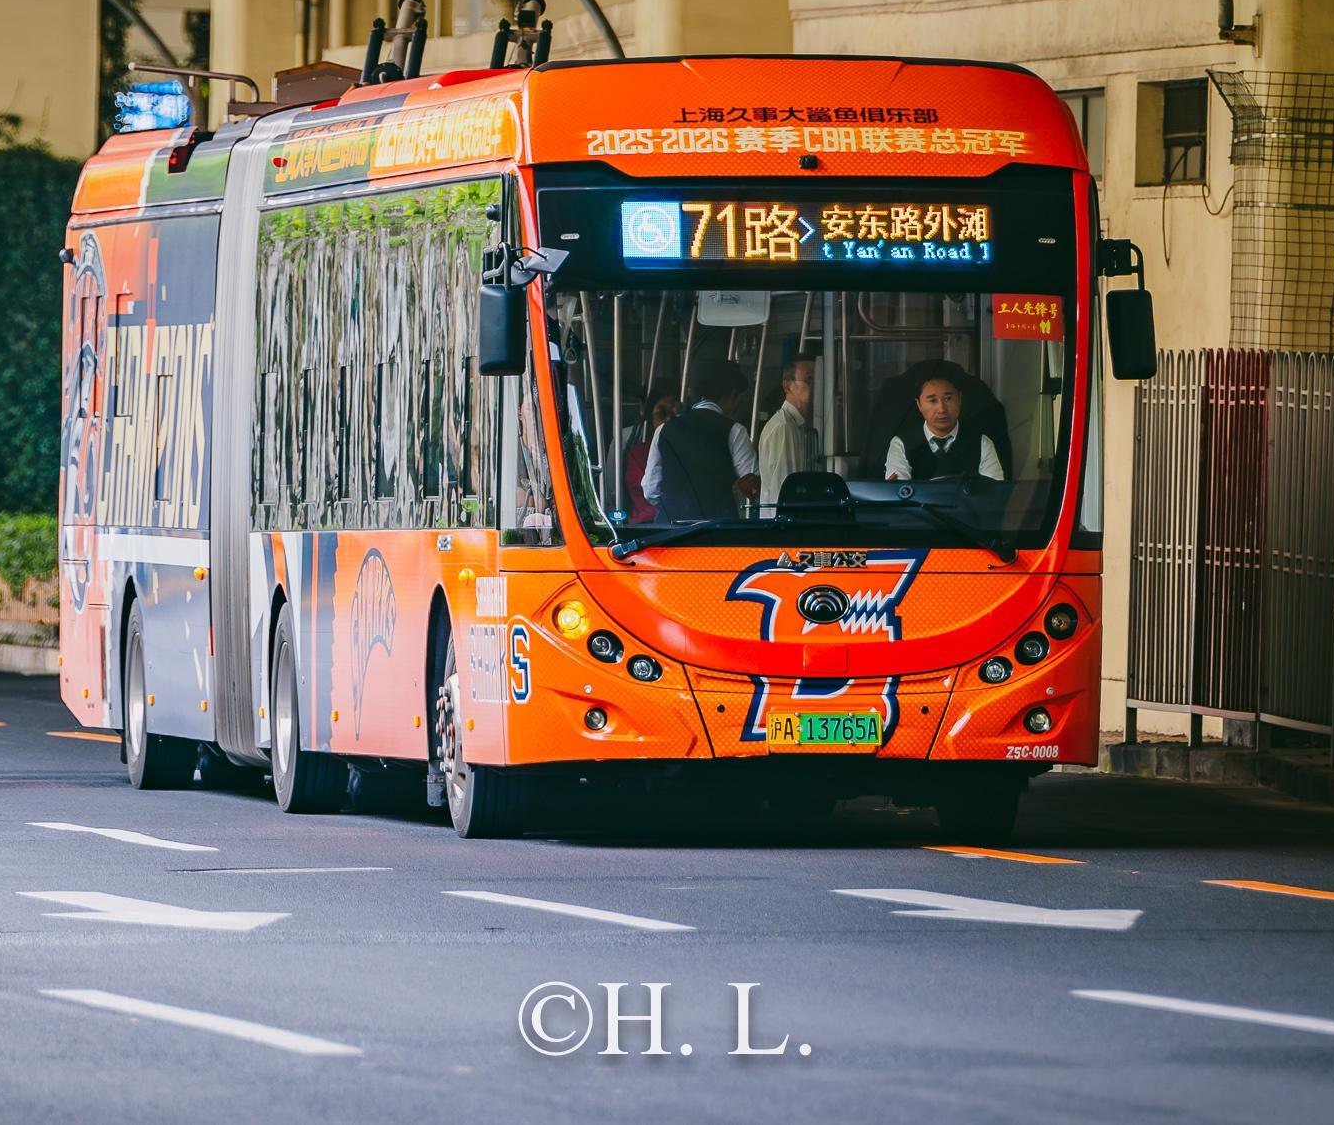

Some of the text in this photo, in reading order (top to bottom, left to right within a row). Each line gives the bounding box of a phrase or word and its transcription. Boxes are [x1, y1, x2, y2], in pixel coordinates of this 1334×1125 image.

[673, 106, 939, 124] 上海久事大鲨鱼俱乐部
[681, 203, 990, 260] 71路 安东路外滩
[923, 242, 972, 260] Road
[998, 301, 1058, 319] 工人先锋号
[97, 323, 212, 530] CHAMPIONS
